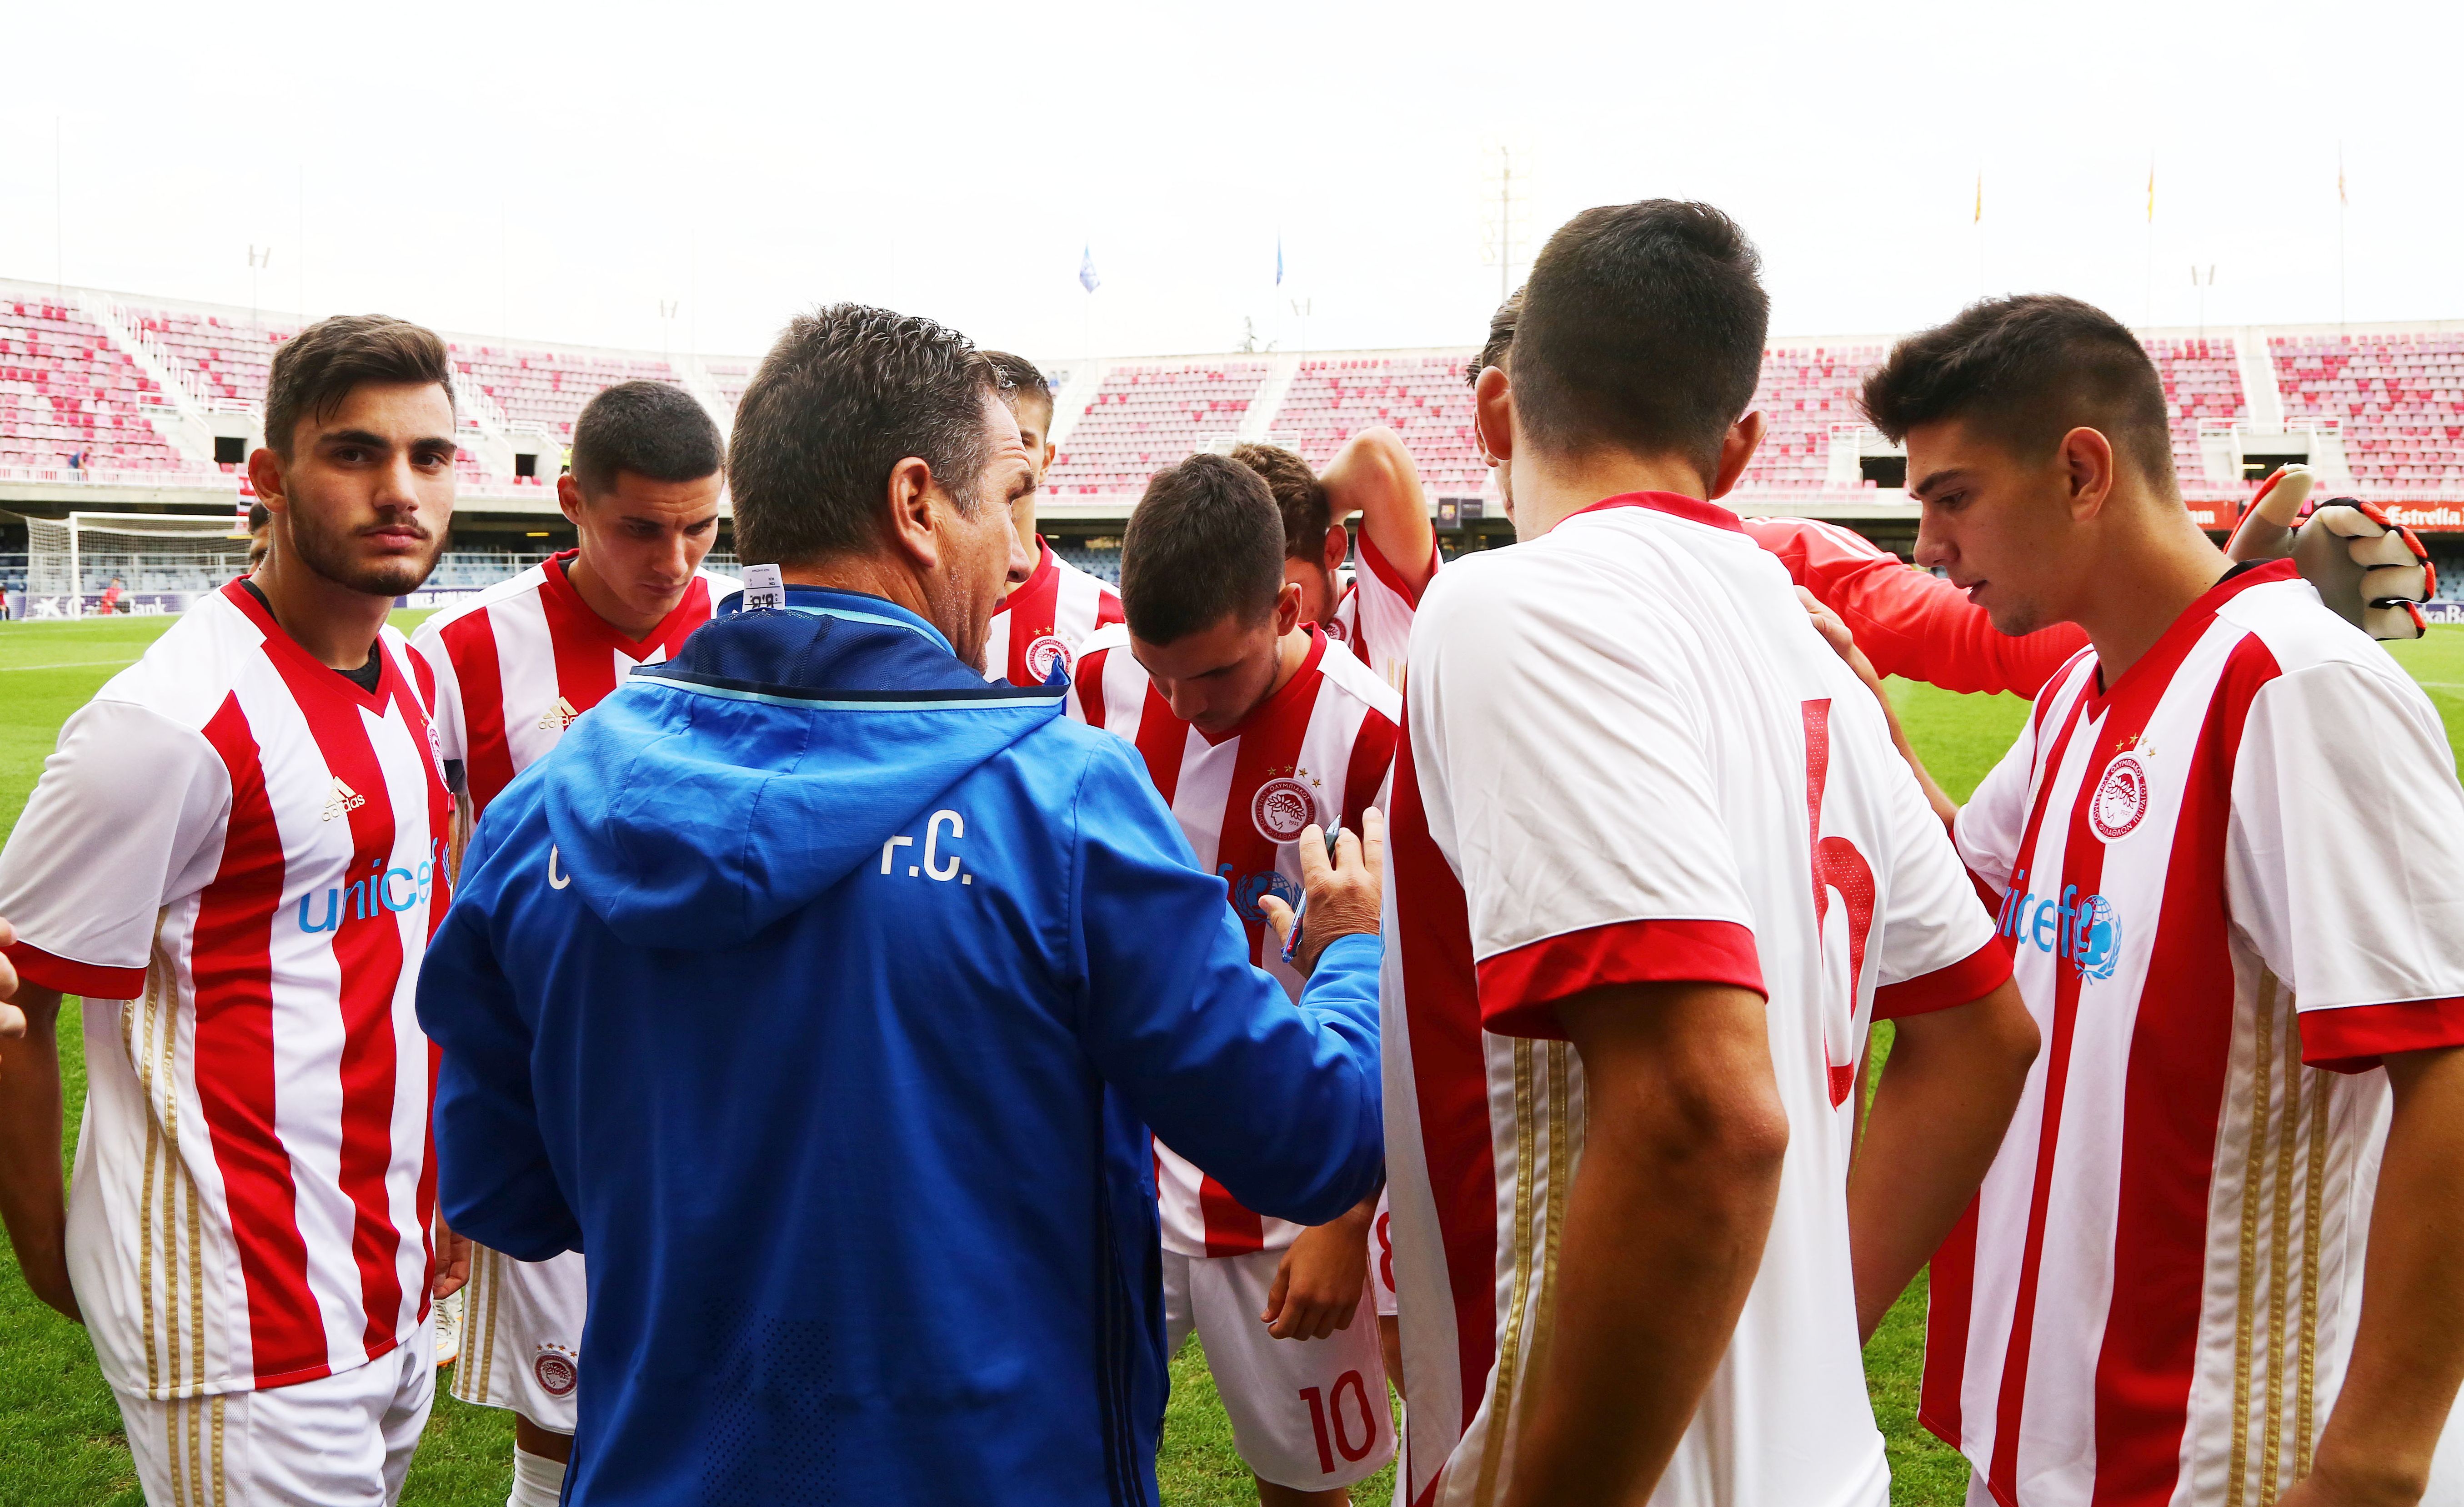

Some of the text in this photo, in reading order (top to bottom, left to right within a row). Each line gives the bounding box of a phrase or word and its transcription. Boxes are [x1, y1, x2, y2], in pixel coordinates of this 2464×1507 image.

[2385, 505, 2460, 526] Estrella
[538, 715, 576, 729] adid
[2111, 760, 2143, 779] ΟΛΥΜΠΙΑΚΟΣ
[1270, 784, 1310, 800] ΟΛΥΜΠΙΑΚΟΣ
[321, 794, 366, 822] adidas
[1299, 1370, 1376, 1474] 10
